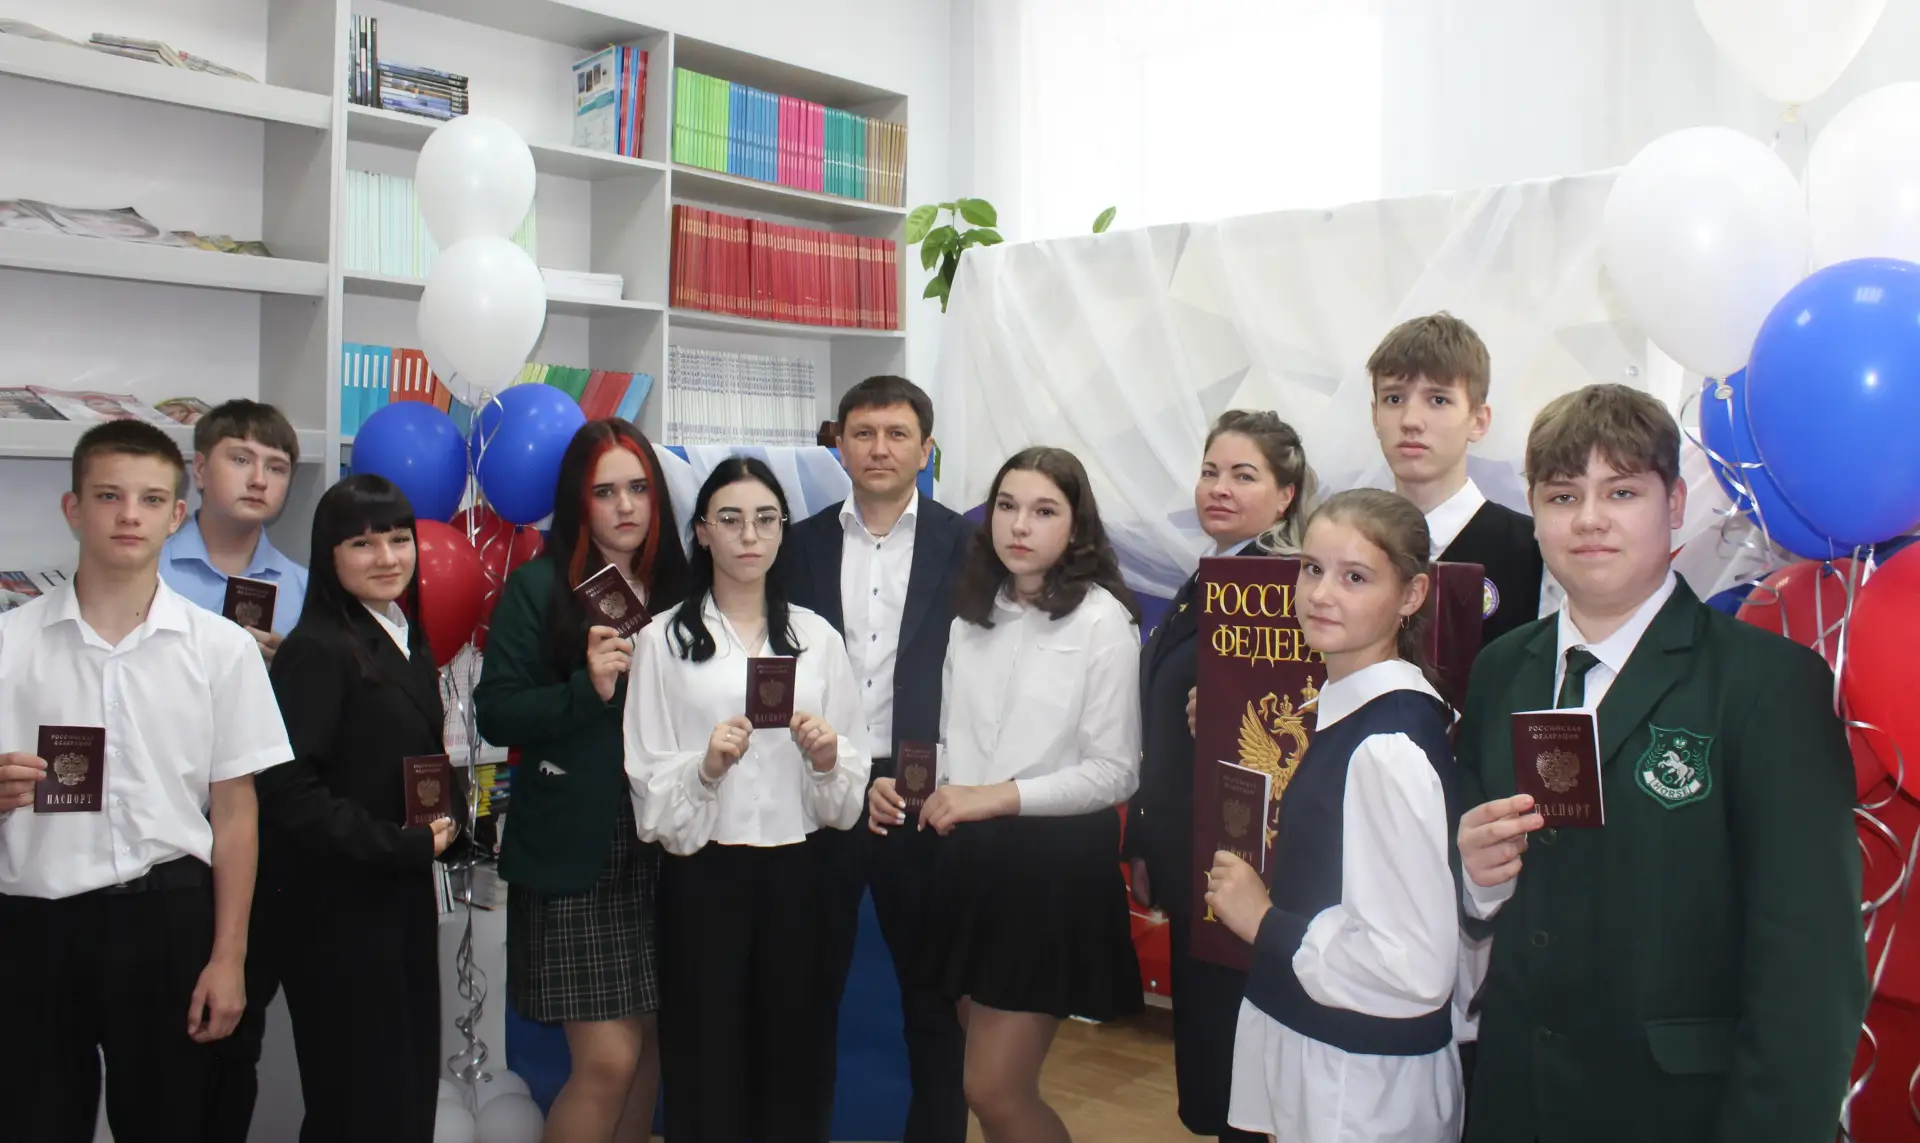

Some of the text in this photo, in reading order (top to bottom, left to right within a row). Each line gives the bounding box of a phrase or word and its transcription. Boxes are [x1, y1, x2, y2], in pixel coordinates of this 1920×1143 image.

[1204, 581, 1297, 618] РОССИ
[1211, 623, 1326, 668] ФЕДЕР
[46, 794, 93, 805] ПАСПОРТ
[1652, 781, 1689, 798] HORSE
